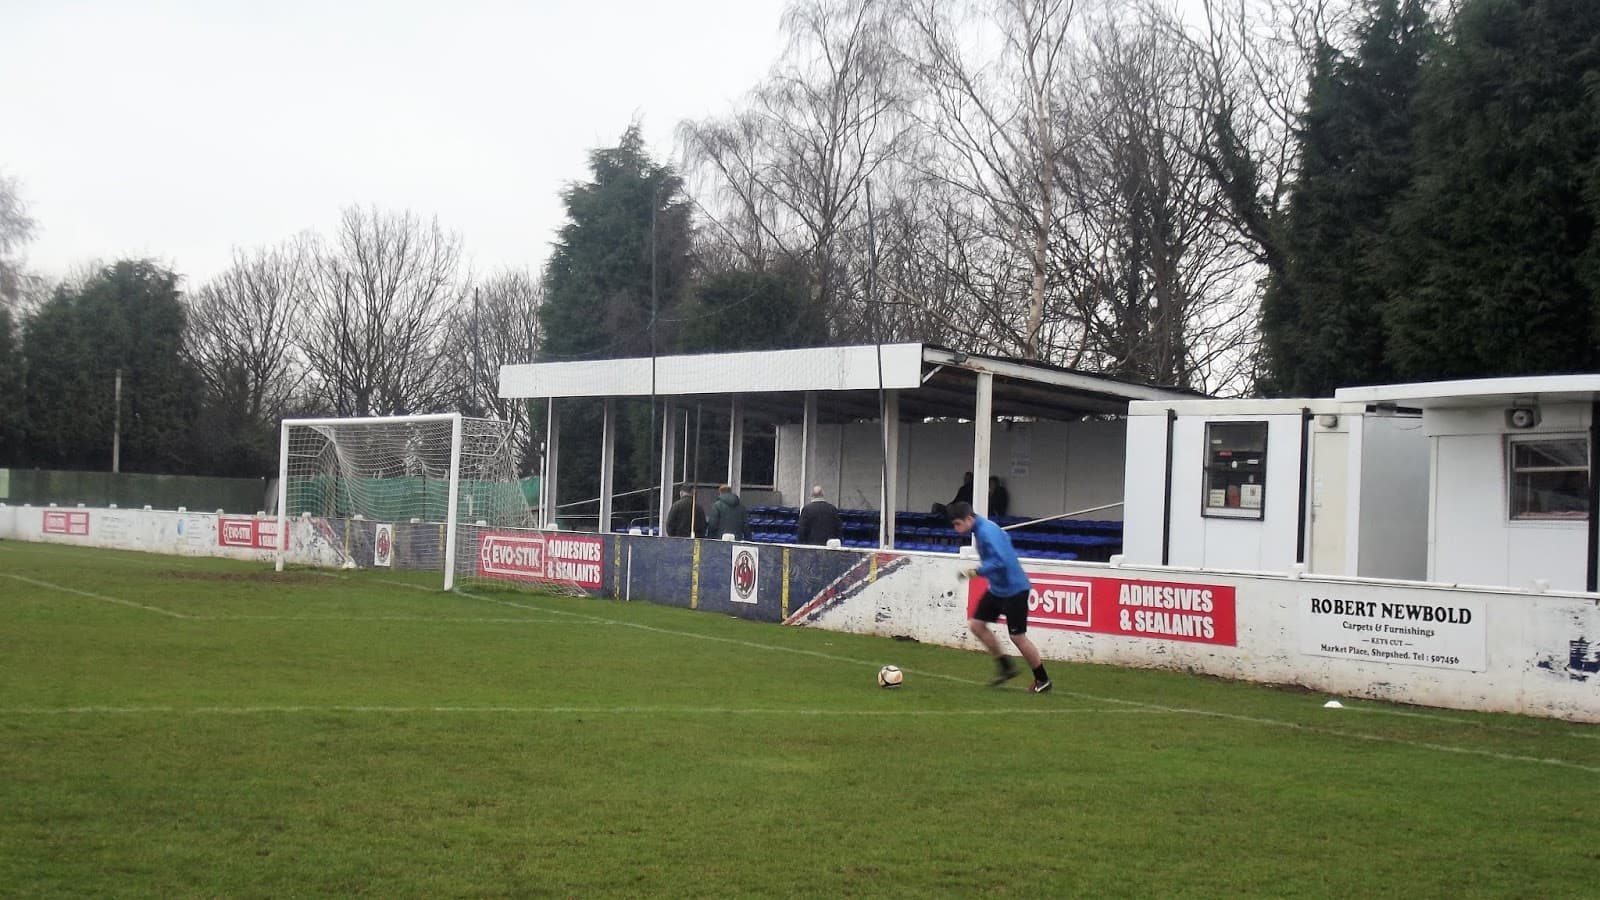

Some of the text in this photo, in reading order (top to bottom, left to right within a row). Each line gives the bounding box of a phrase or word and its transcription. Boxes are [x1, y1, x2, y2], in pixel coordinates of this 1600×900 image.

[492, 545, 540, 567] EVO-STIK
[547, 539, 601, 561] ADHESIVES
[547, 561, 601, 584] & SEALANTS
[1027, 588, 1084, 615] O-STIK
[1119, 584, 1213, 612] ADHESIVES
[1311, 598, 1472, 624] ROBERT NEWBOLD
[1120, 609, 1214, 639] & SEALANTS
[1342, 620, 1435, 638] Carpets & Furnishings
[1371, 637, 1403, 647] KEYS CUT
[1321, 643, 1347, 653] Market
[1431, 655, 1460, 664] 507456
